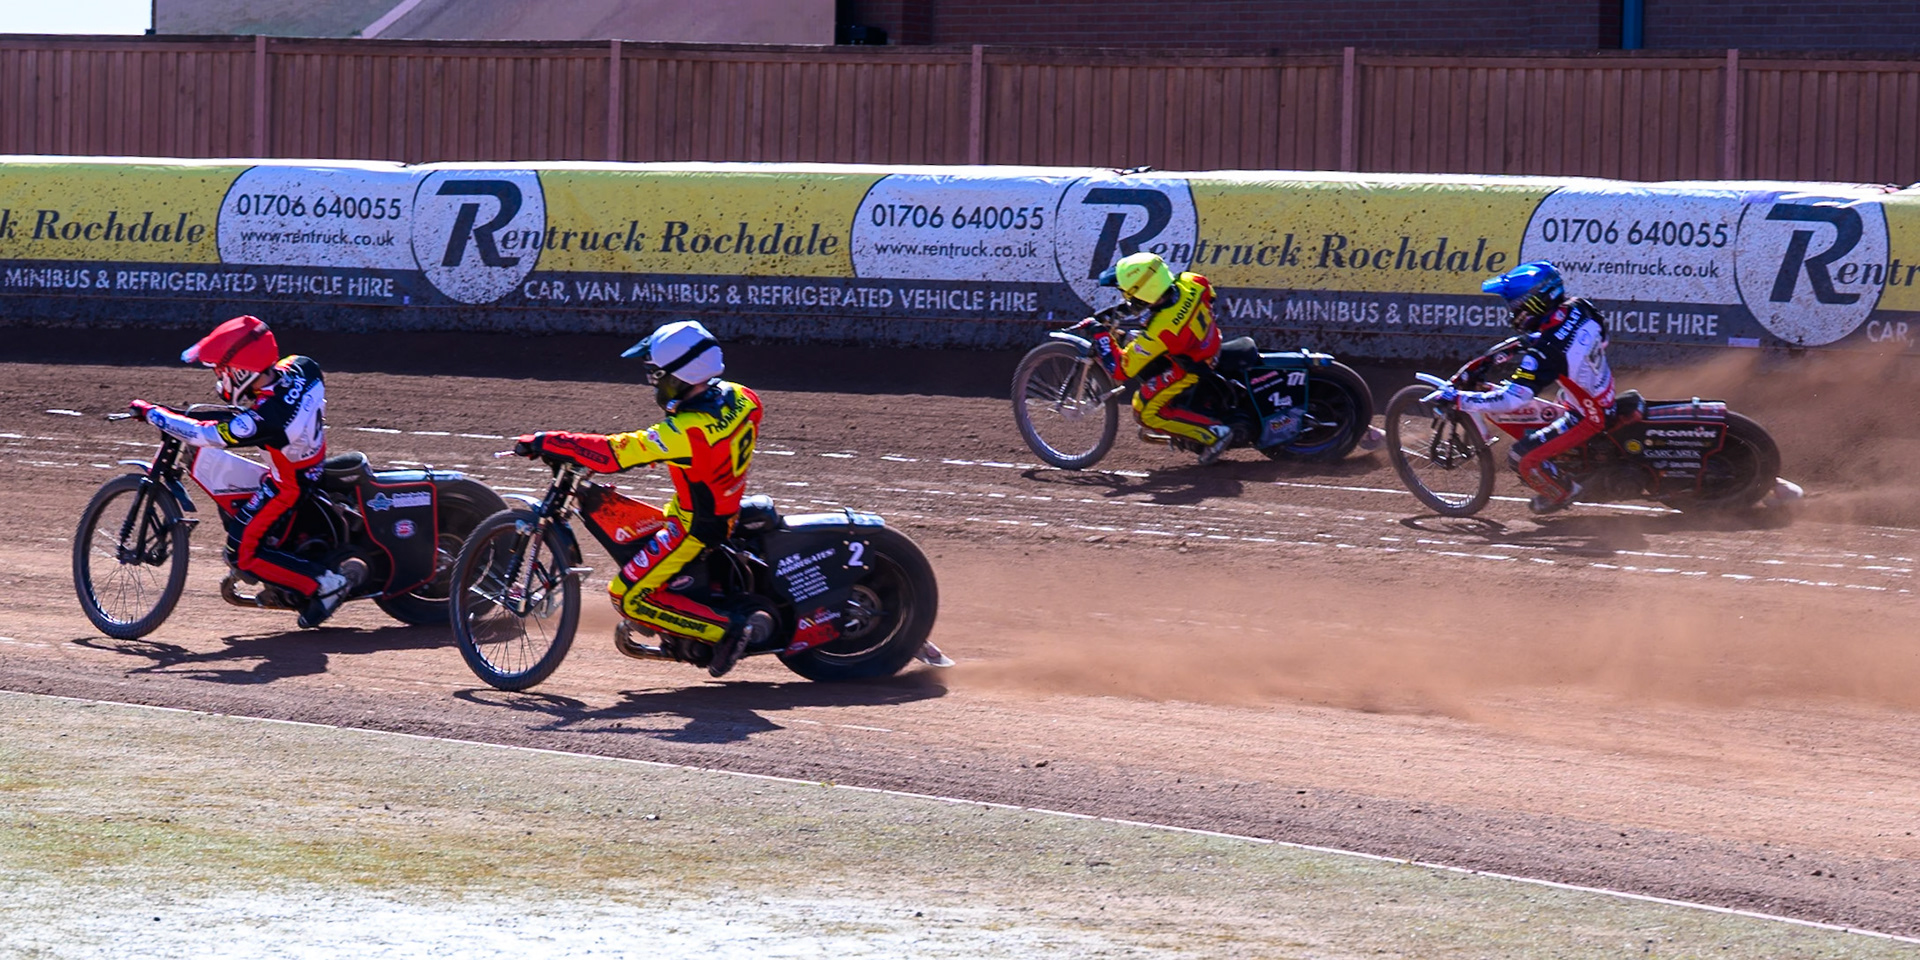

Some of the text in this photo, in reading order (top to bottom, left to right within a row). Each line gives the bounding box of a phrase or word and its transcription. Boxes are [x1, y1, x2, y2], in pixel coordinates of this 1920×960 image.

[237, 194, 401, 220] 01706 640055
[872, 203, 1044, 230] 01706 640055
[32, 208, 206, 244] Rochdale
[241, 228, 394, 247] www.rentruck.co.uk
[436, 180, 839, 267] Rentruck Rochdale
[1082, 188, 1506, 279] Rentruck Rochdale
[1542, 218, 1728, 248] 01706 640055
[875, 241, 1037, 258] www.rentruck.co.uk
[1765, 203, 1920, 304] Rentr
[4, 267, 394, 297] MINIBUS & REFRIGERATED VEHICLE HIRE
[523, 280, 1038, 312] CAR, VAN, MINIBUS & REFRIGERATED VEHICLE HIRE
[1226, 297, 1719, 337] VAN, MINIBUS & REFRIGER HICLE HIRE
[284, 375, 307, 405] COOK
[848, 542, 864, 567] 2
